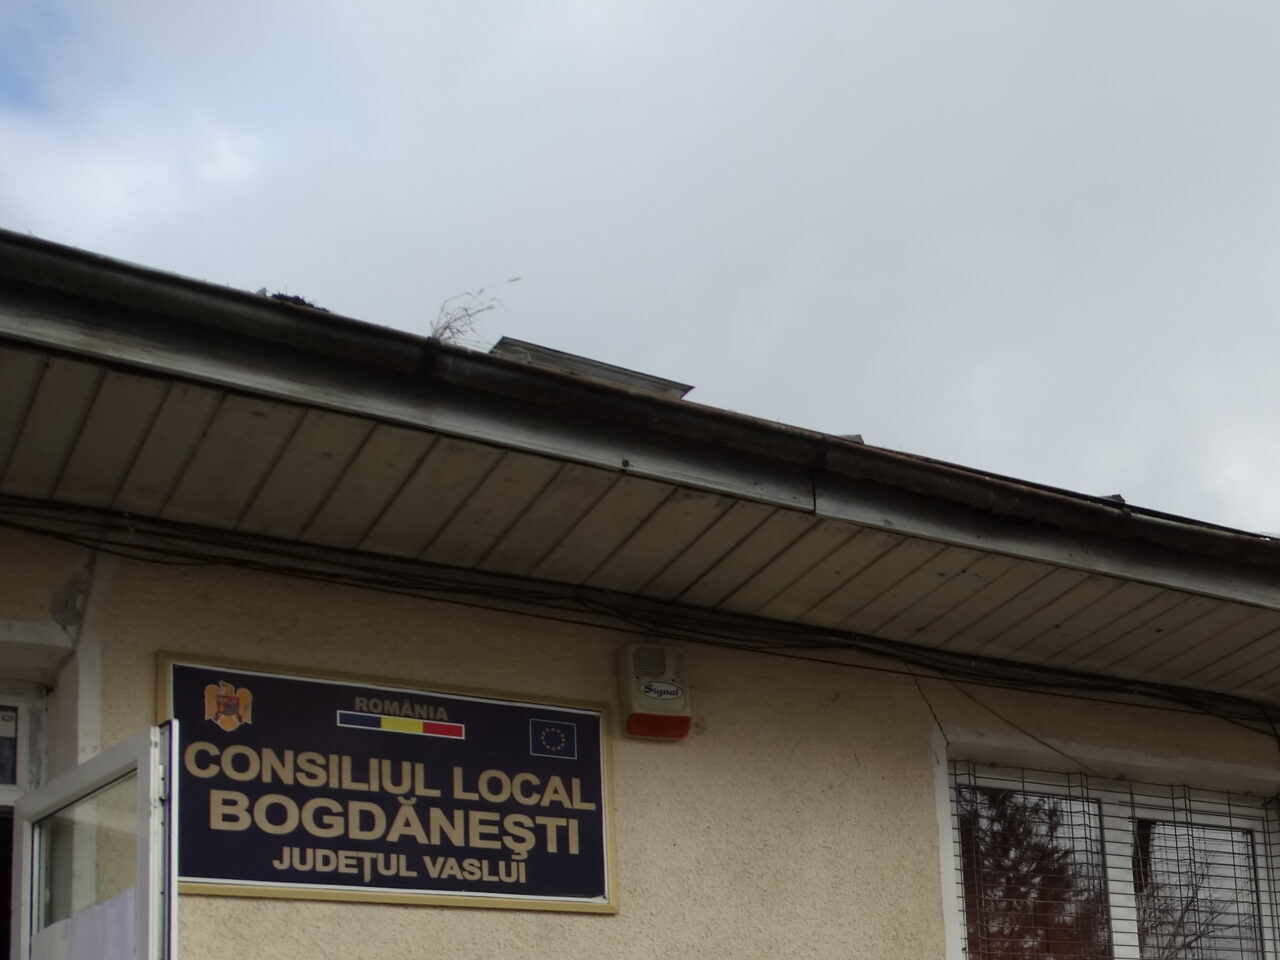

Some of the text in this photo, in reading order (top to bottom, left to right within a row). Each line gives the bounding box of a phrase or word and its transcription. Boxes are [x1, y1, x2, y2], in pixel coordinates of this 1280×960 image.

[643, 684, 679, 697] Signal
[354, 697, 449, 721] ROMÂNIA
[184, 741, 596, 811] CONSILIUL LOCAL
[422, 855, 526, 884] VASLUI
